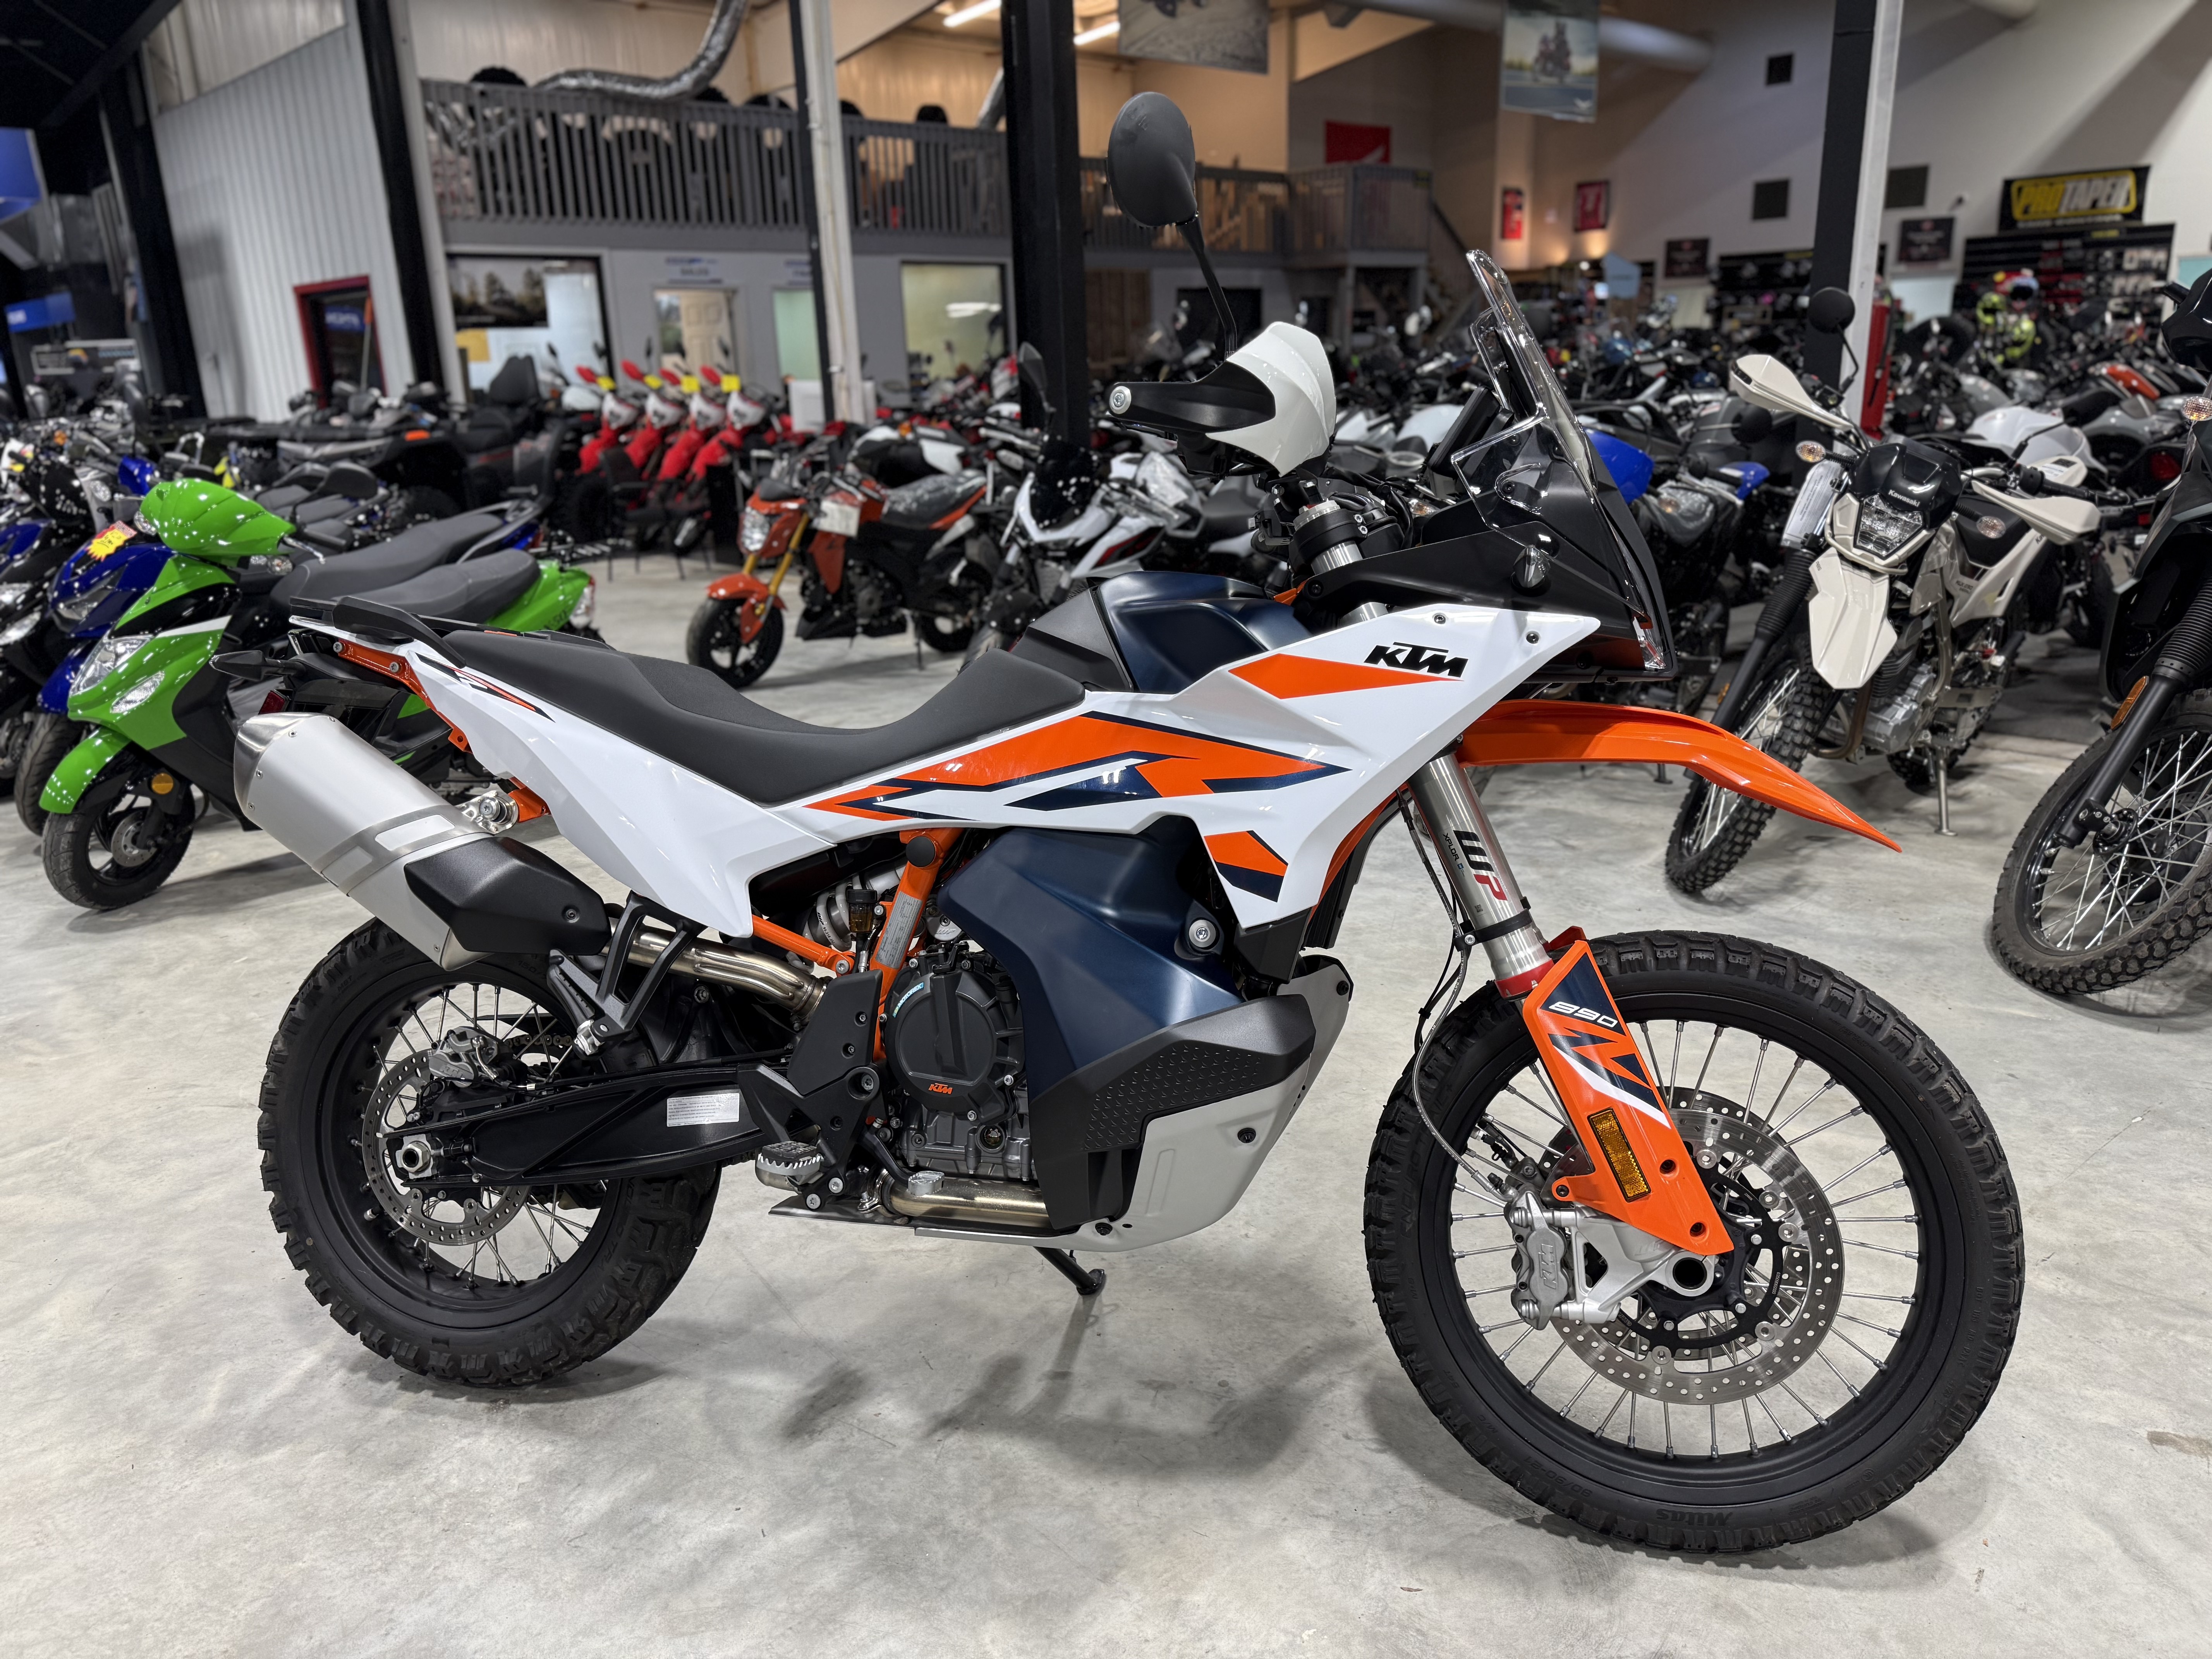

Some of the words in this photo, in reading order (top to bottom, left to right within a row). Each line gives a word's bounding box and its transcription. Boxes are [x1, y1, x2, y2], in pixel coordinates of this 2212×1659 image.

[1889, 489, 1920, 507] Kawasaki
[1364, 642, 1468, 678] KTM
[1443, 833, 1459, 861] XPLOR
[1453, 830, 1508, 901] WP
[896, 984, 922, 1008] MOTOREX
[1548, 1001, 1618, 1028] 890
[929, 1083, 952, 1094] KTM
[1538, 1243, 1557, 1290] KTM
[1477, 1413, 1499, 1434] M/C
[1520, 1454, 1594, 1499] 90/90-21
[1654, 1508, 1734, 1528] Mitas
